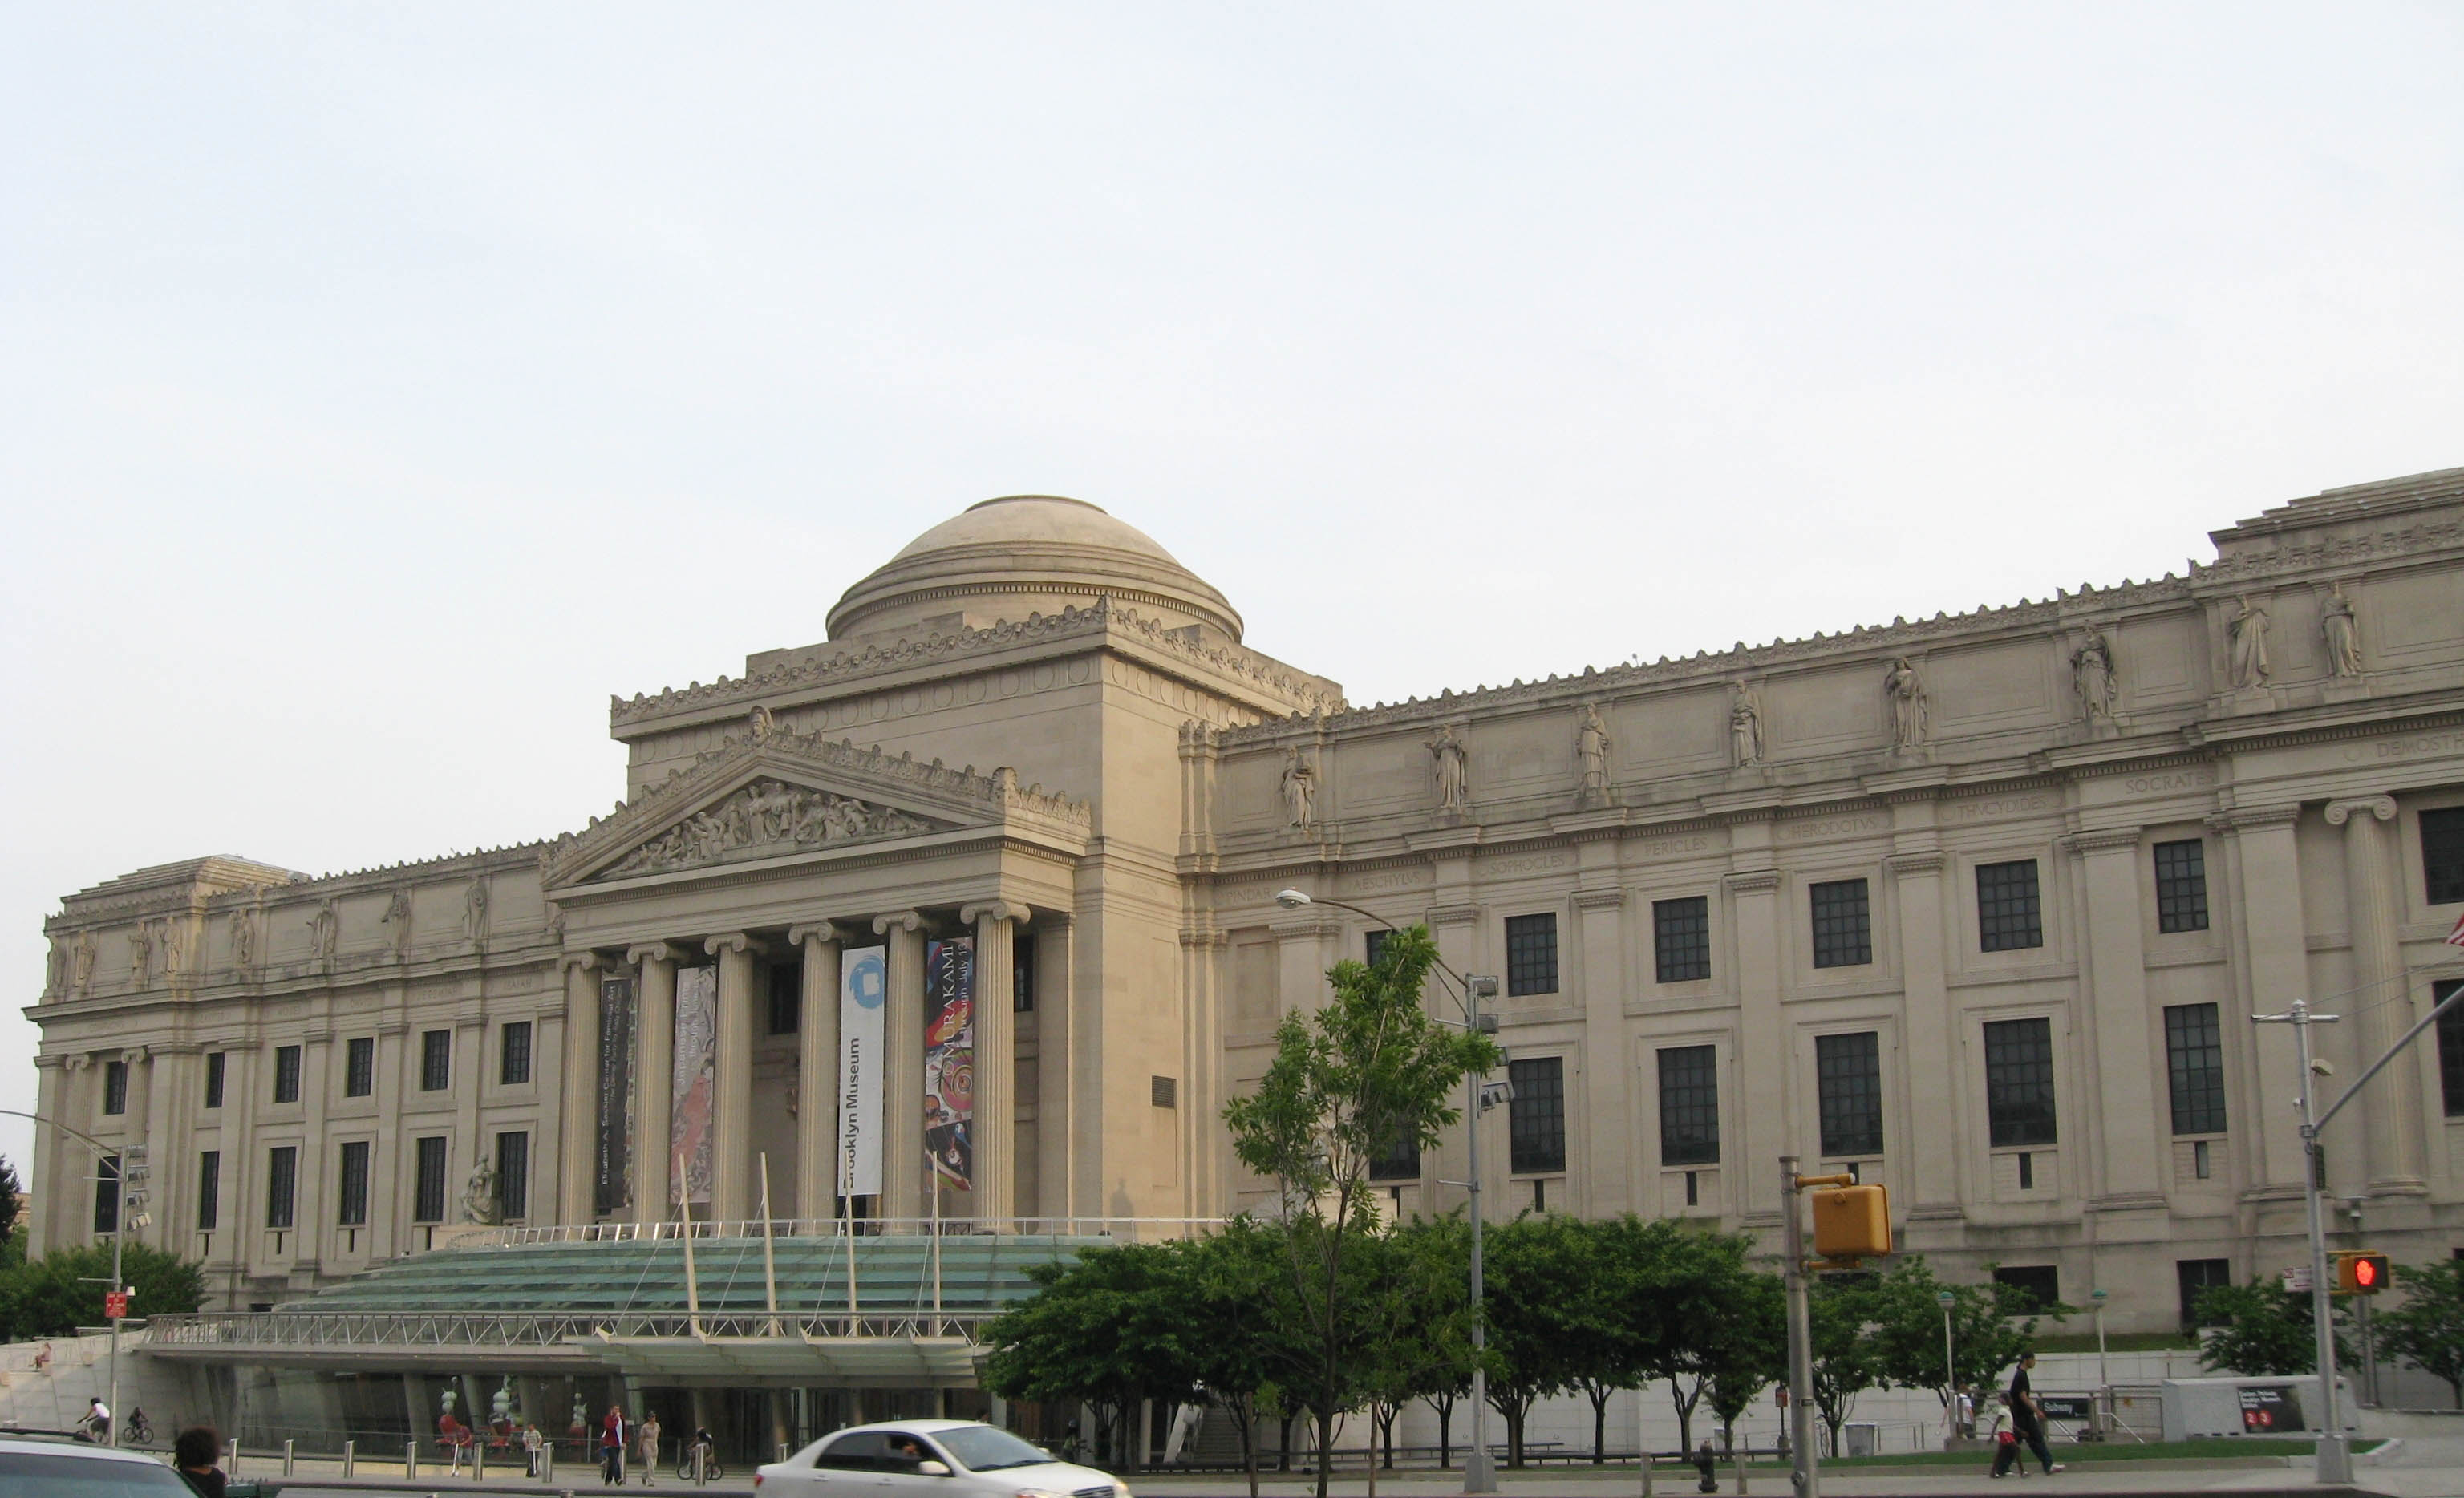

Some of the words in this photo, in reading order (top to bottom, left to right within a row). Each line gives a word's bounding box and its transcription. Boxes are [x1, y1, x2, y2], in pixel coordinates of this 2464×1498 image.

[2126, 771, 2215, 794] SOCRATES
[1790, 817, 1875, 840] HERODOTVS
[1645, 836, 1708, 856] PERICLES
[1489, 856, 1563, 874] SOPHOCLES
[958, 943, 967, 955] 13
[958, 960, 969, 982] July
[607, 985, 615, 1001] Art
[958, 987, 969, 1034] through
[677, 1022, 687, 1084] Japanese
[845, 1038, 860, 1109] Museum
[2044, 1402, 2073, 1415] Subway
